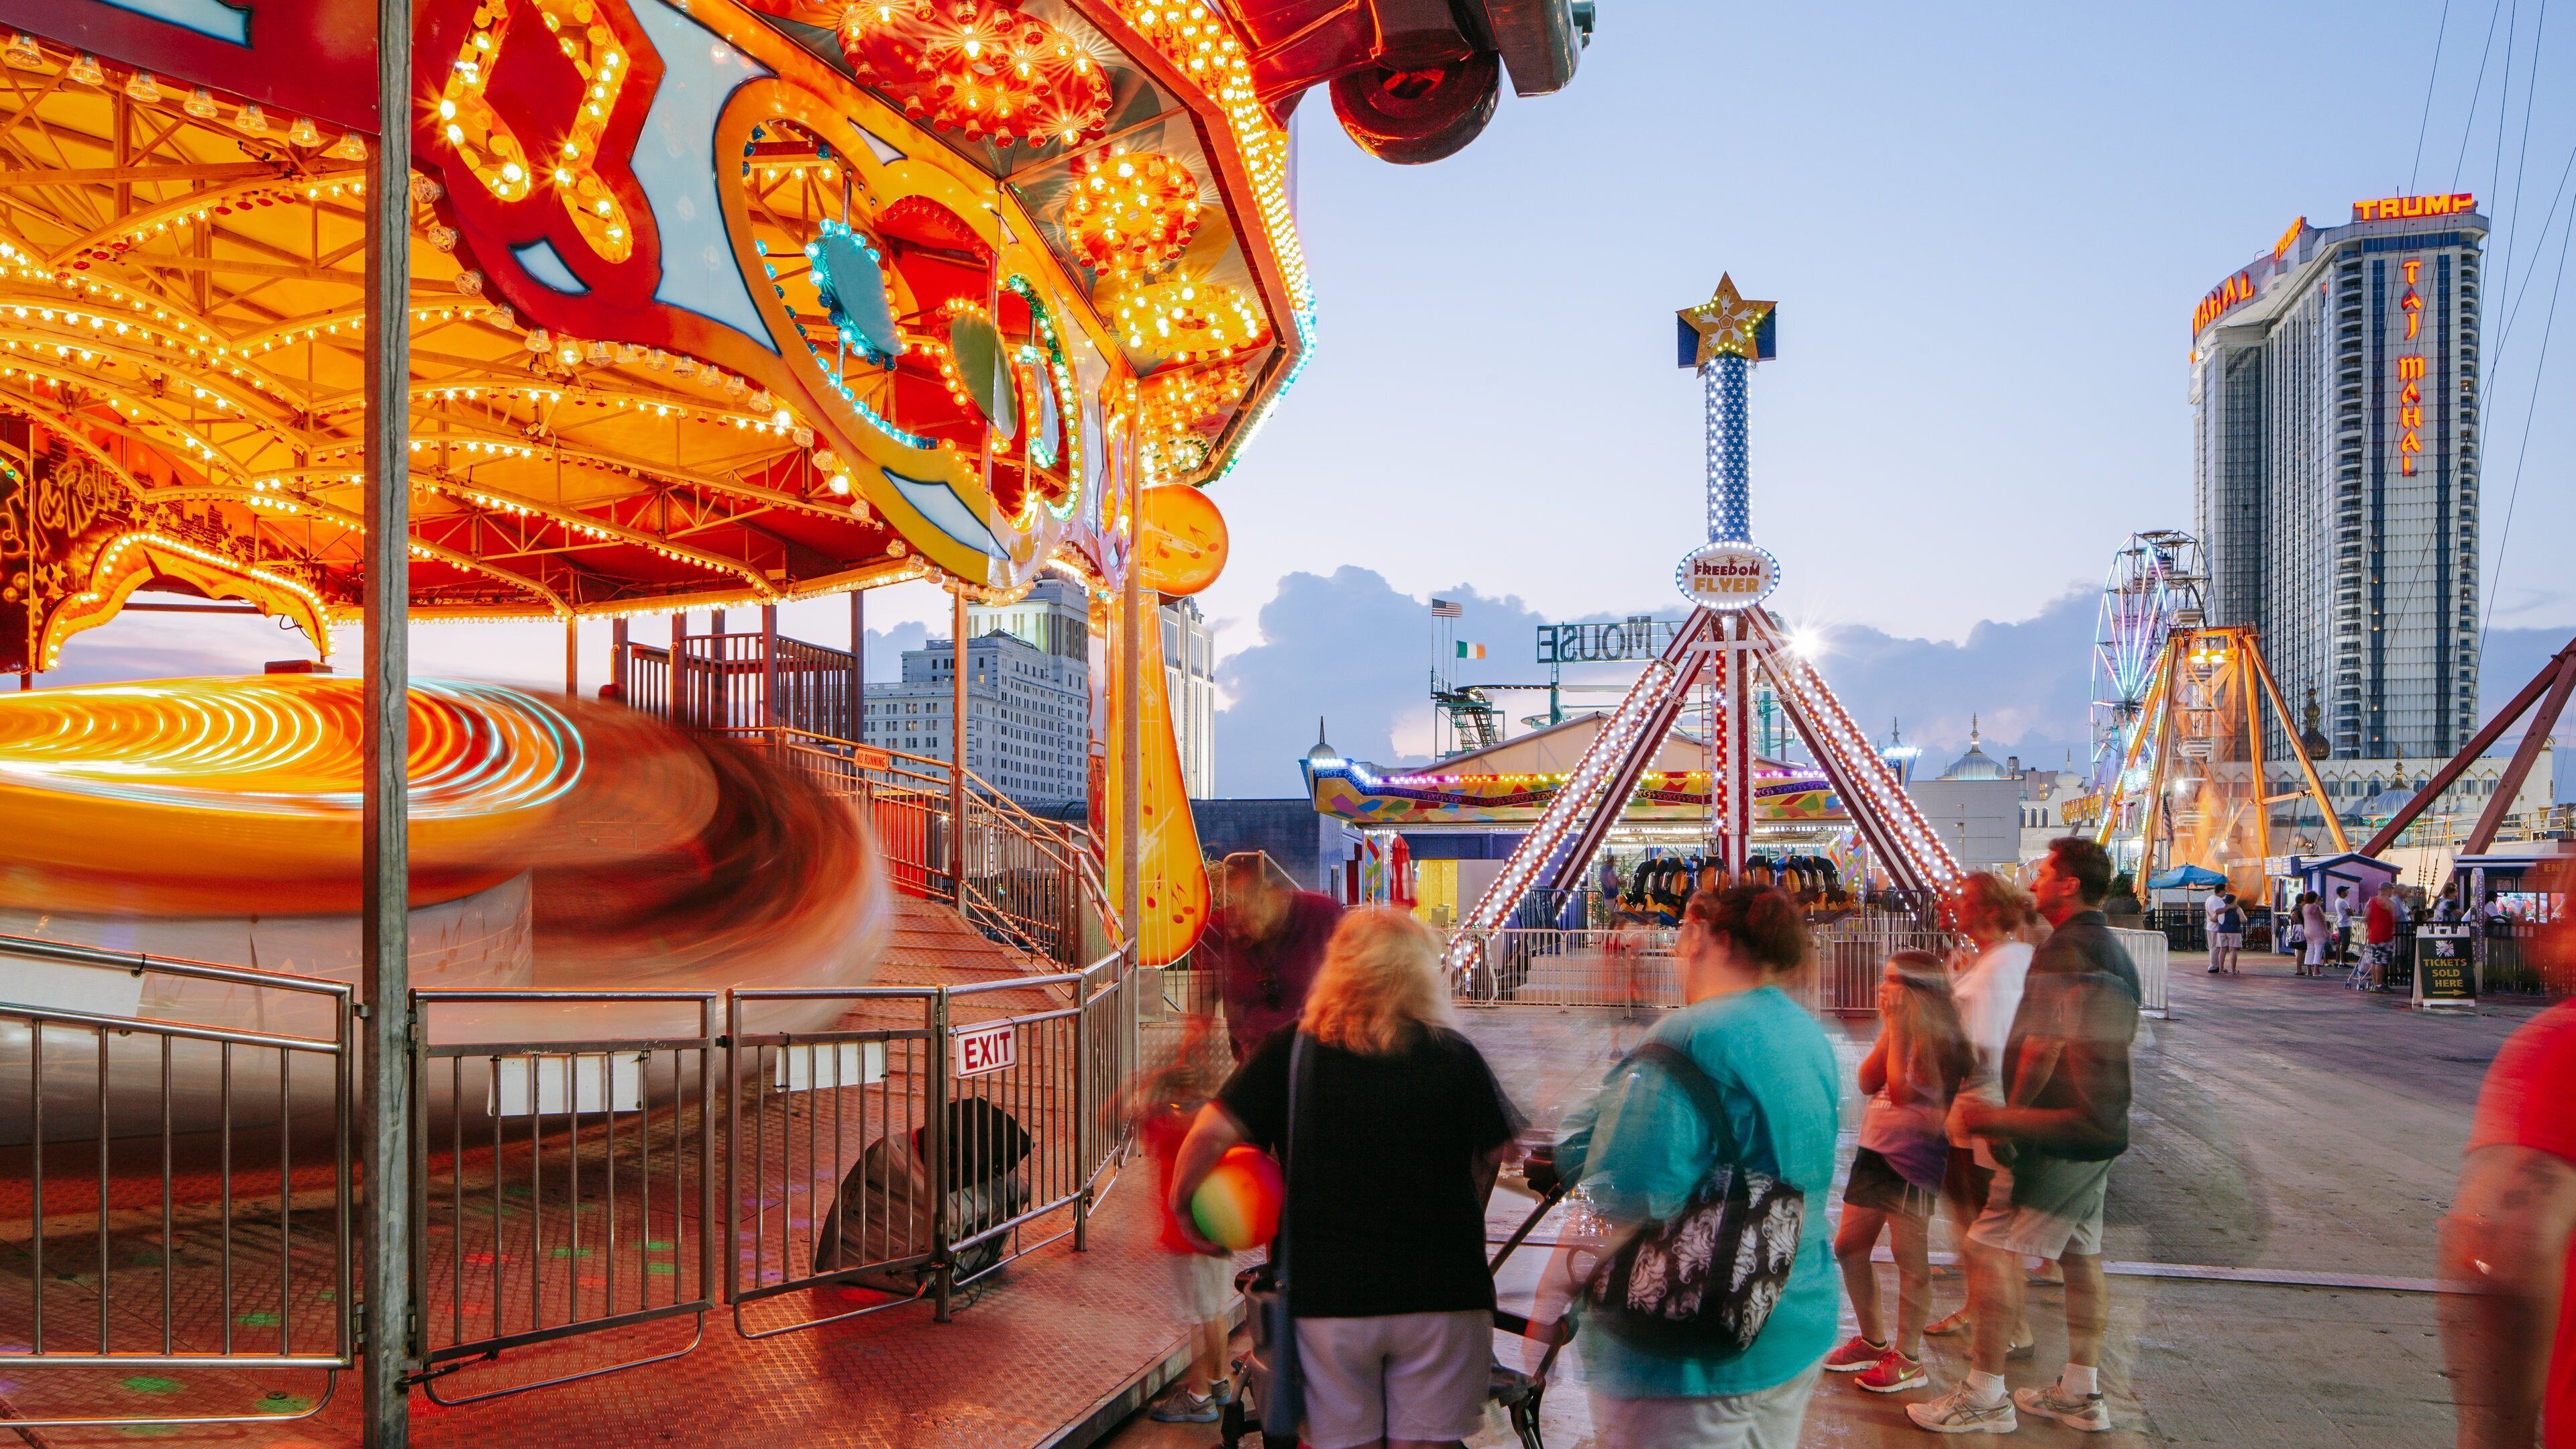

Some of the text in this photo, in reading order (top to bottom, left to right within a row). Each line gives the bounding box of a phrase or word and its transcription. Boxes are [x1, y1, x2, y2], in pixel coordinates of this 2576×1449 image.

[2354, 193, 2473, 220] TRUMP
[2275, 216, 2302, 259] TRUMP
[2399, 260, 2424, 477] TAJ MAHAL
[1693, 559, 1760, 576] FREEDOM
[1693, 578, 1760, 593] FLYER
[857, 753, 885, 767] NO RUNNING
[2423, 959, 2467, 967] TICKETS
[2434, 979, 2463, 987] HERE
[965, 1032, 1010, 1069] EXIT
